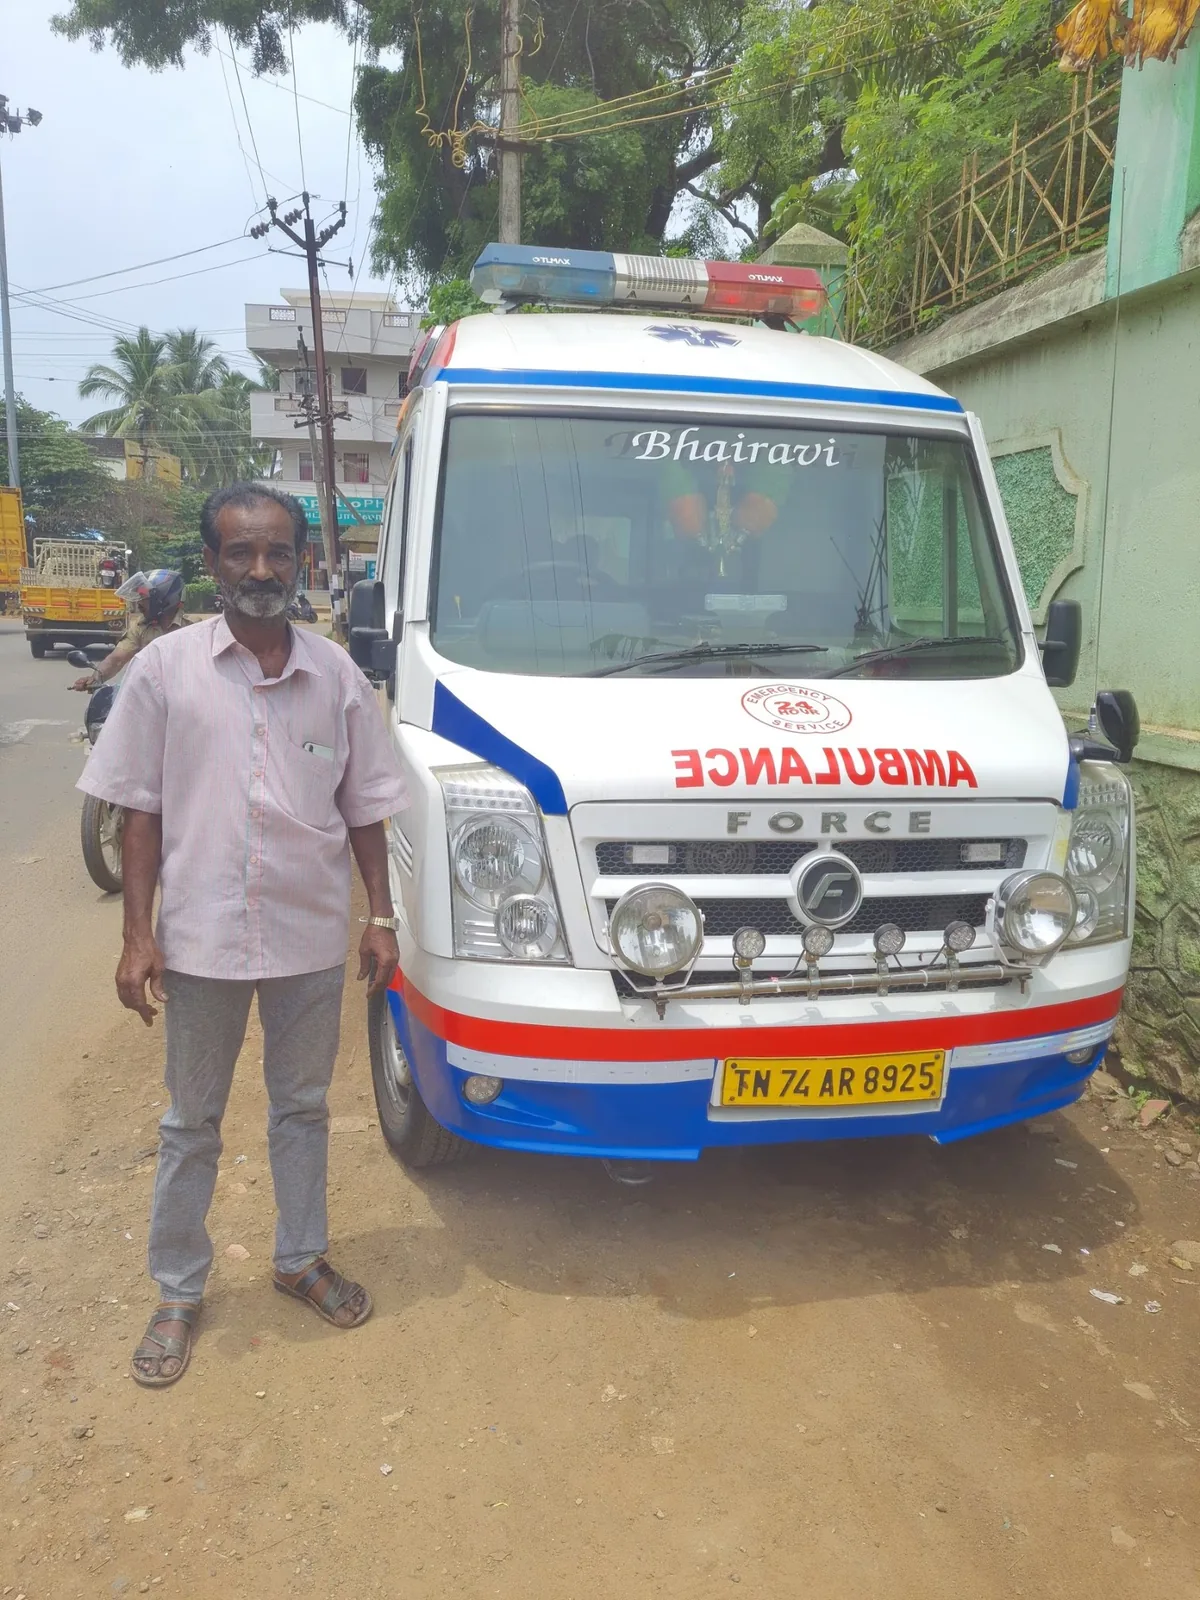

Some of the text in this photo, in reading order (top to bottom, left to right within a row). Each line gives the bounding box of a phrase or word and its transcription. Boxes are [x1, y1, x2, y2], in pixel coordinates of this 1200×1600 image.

[632, 427, 840, 467] Bhairavi
[746, 686, 832, 704] EMERGENCY
[774, 701, 814, 710] 24
[777, 708, 820, 716] HOUR
[772, 720, 844, 731] SERVICE
[727, 810, 932, 834] FORCE
[734, 1061, 936, 1098] TN 74 AR 8925
